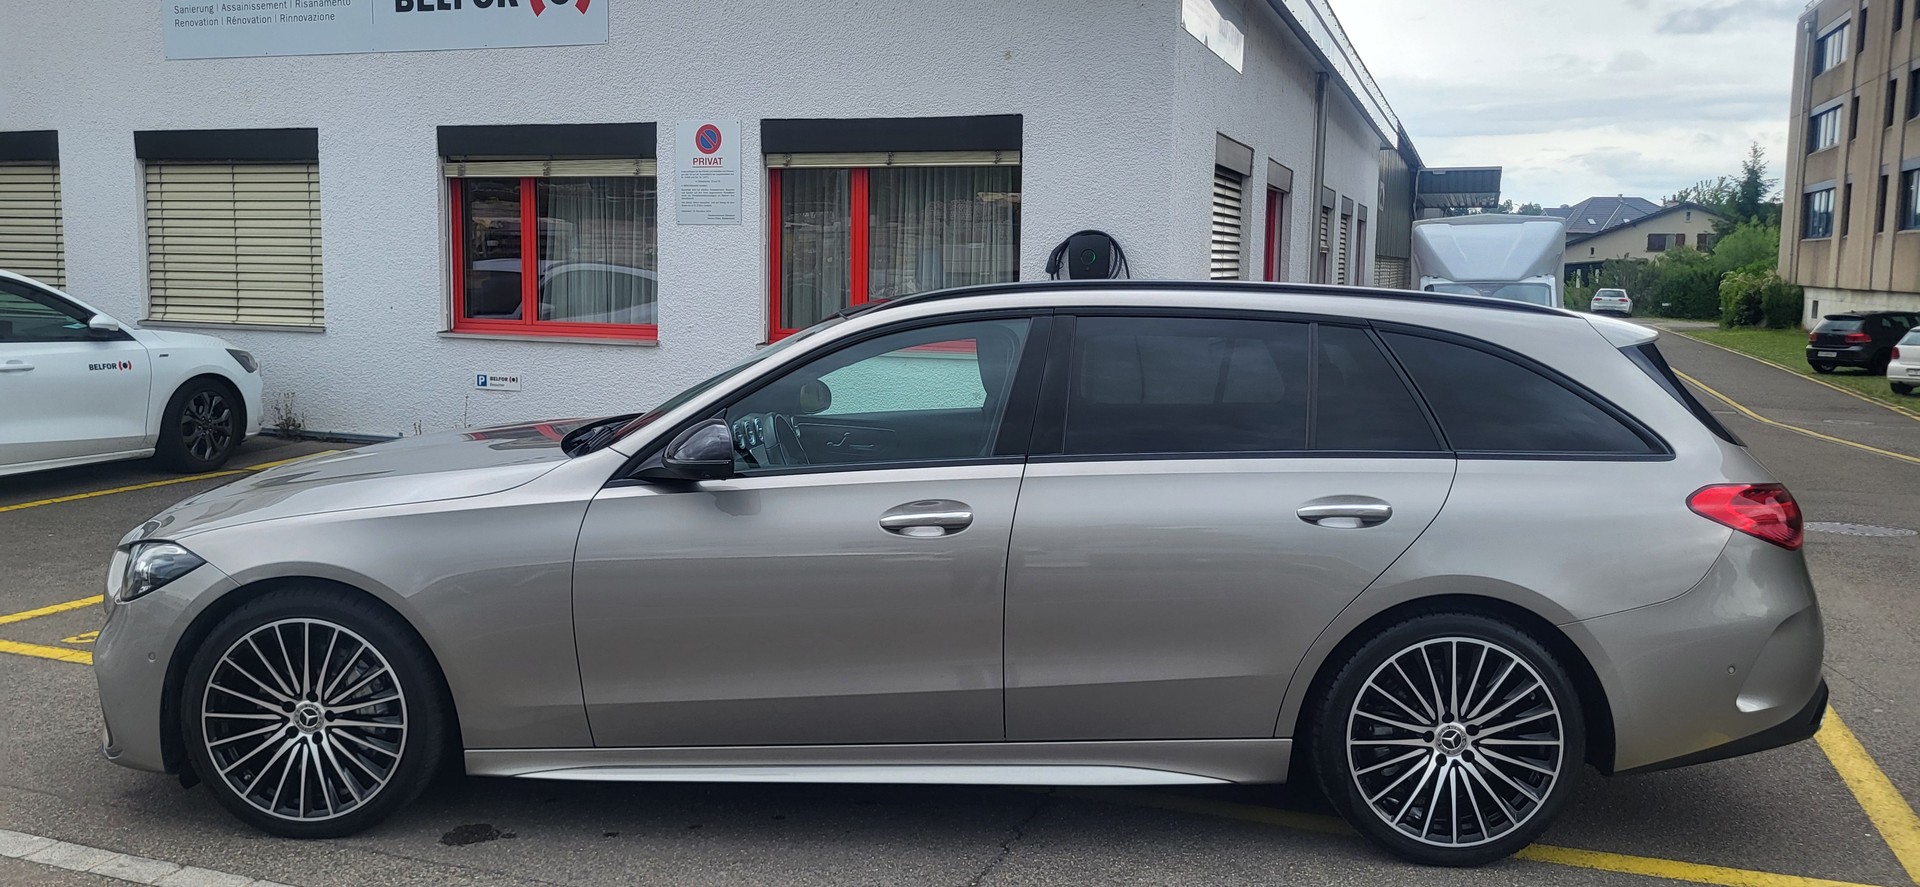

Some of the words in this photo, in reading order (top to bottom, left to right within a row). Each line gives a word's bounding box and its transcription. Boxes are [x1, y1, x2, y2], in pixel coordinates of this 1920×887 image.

[174, 5, 214, 14] Sanierung
[221, 1, 287, 12] Assainissement
[174, 17, 219, 27] Renovation
[226, 15, 272, 25] Rénovation
[280, 12, 336, 22] Rinnovazione
[88, 363, 117, 371] BELFOR
